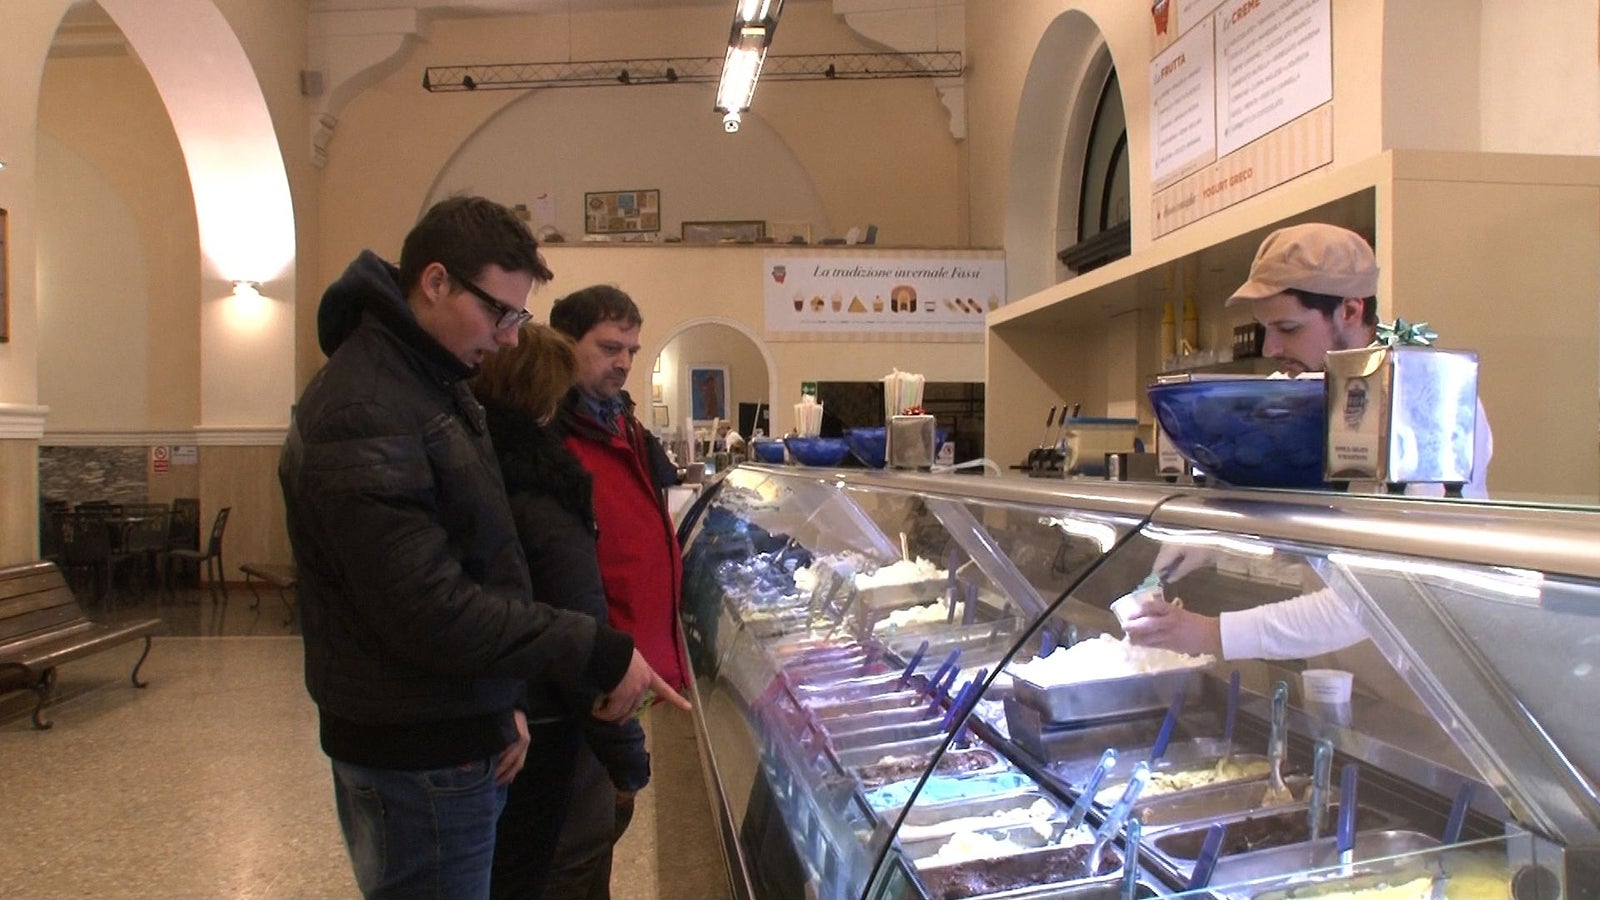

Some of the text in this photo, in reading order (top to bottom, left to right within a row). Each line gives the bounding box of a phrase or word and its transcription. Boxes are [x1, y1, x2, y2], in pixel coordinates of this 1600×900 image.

[1161, 53, 1186, 79] FRUTTA
[1203, 168, 1253, 199] YOGURT GRECO
[813, 265, 981, 279] La tradizione invernale Fassi
